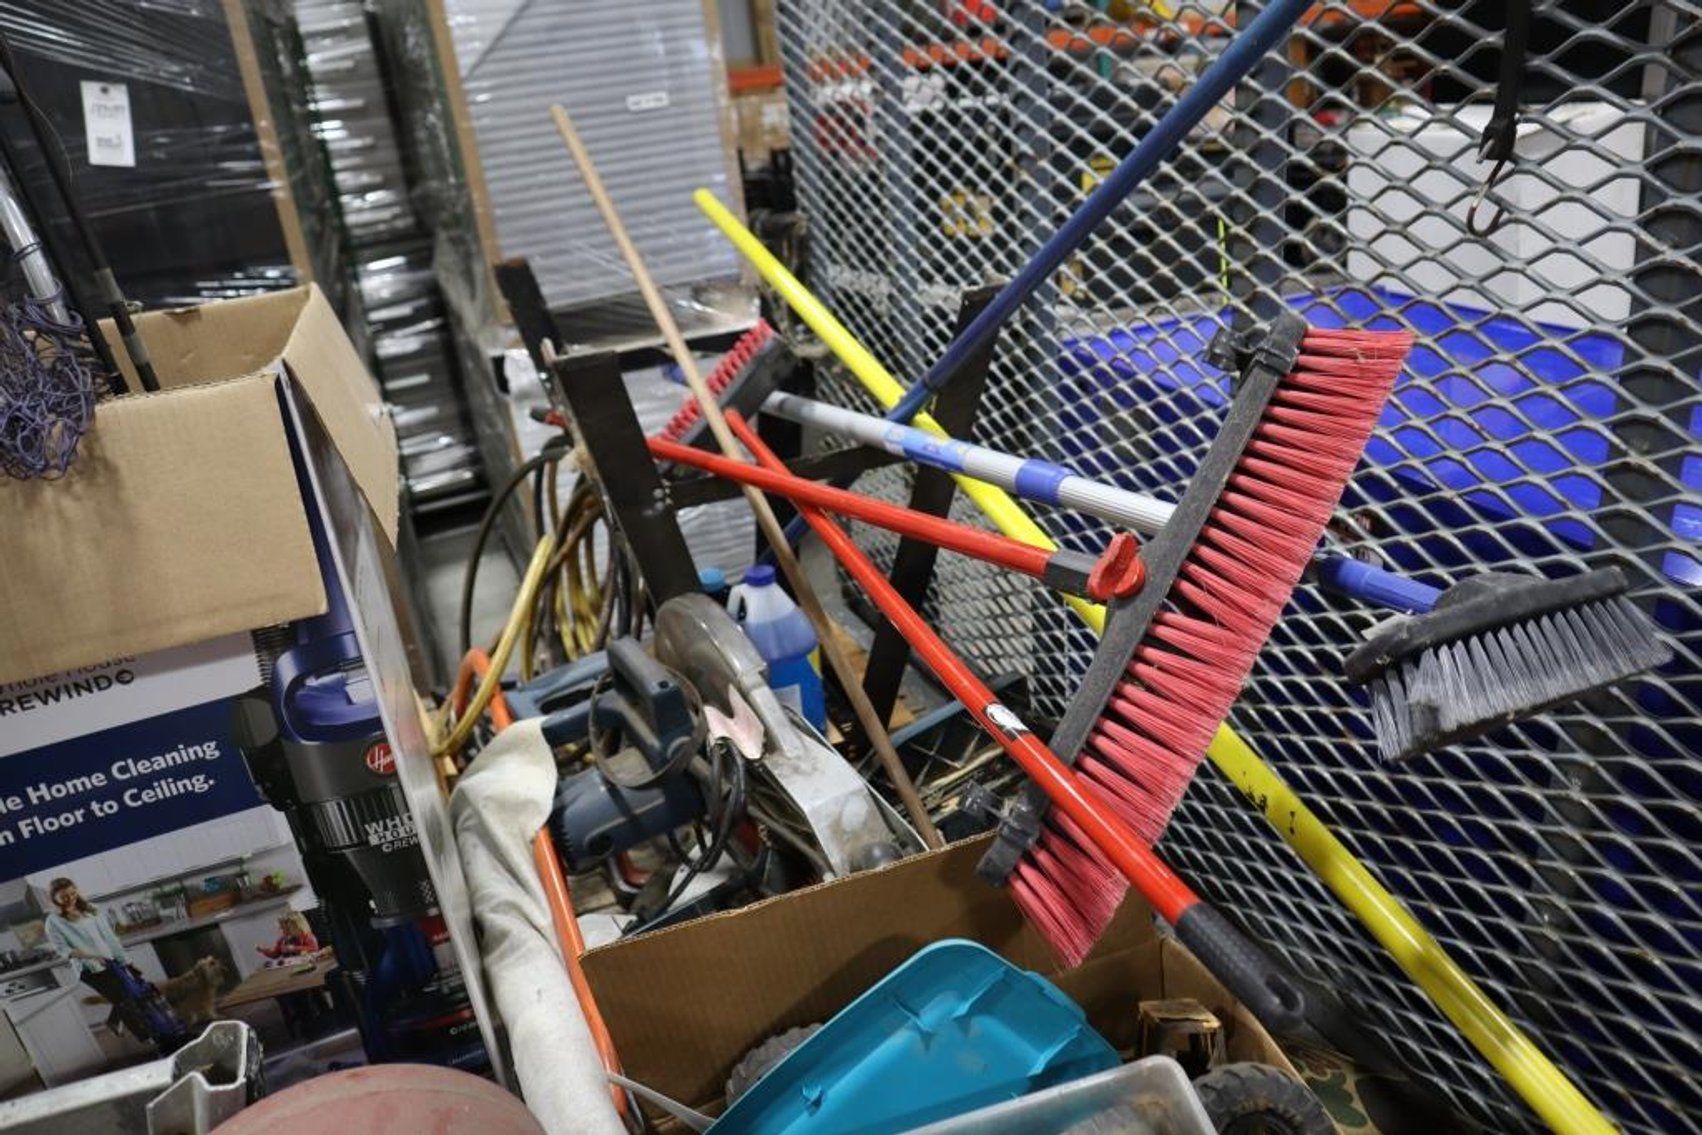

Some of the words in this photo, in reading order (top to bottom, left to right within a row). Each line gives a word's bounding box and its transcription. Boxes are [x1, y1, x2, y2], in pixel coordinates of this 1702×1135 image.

[25, 770, 108, 805] Home
[110, 740, 221, 781] Cleaning
[17, 806, 86, 840] Floor
[90, 799, 120, 818] to
[122, 773, 216, 808] Ceiling.
